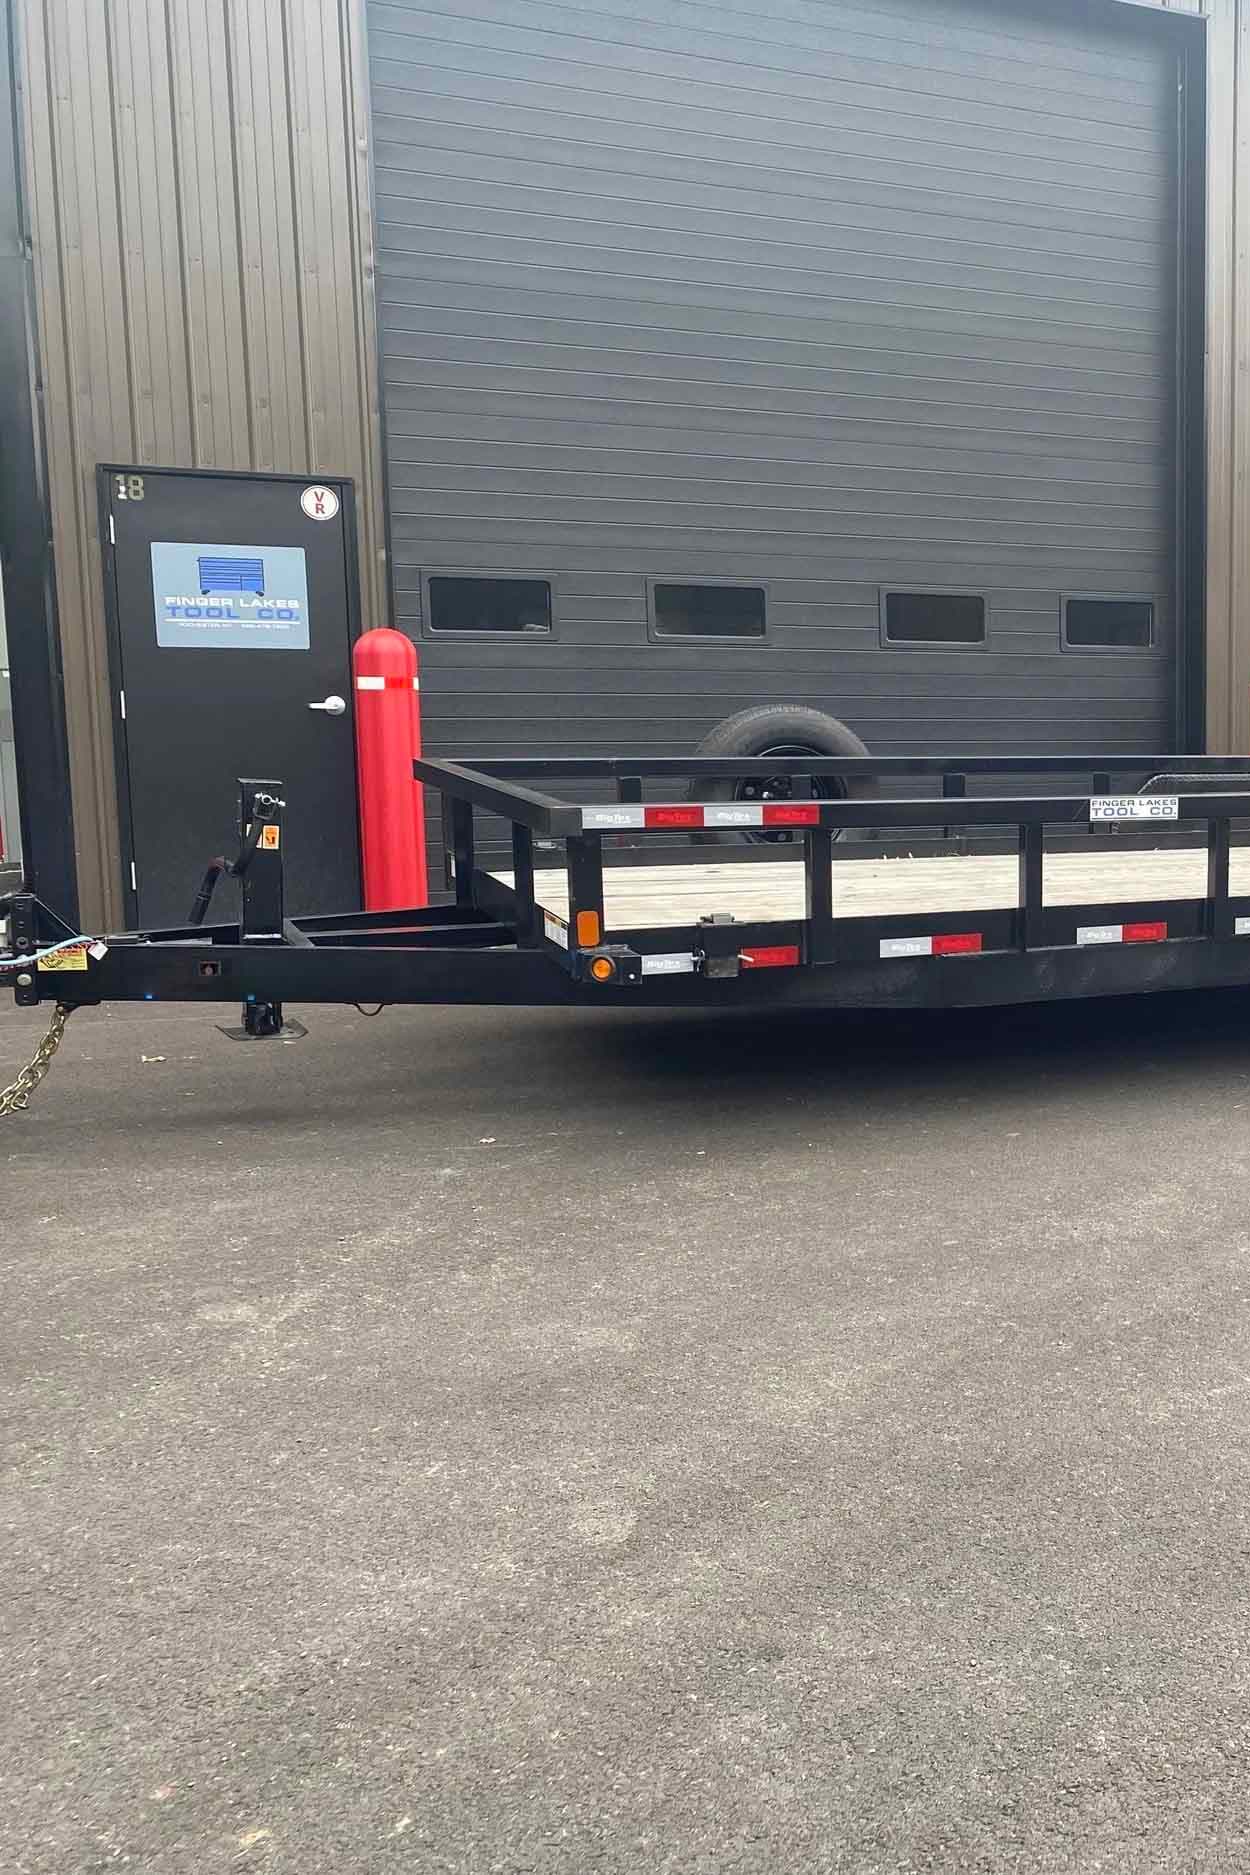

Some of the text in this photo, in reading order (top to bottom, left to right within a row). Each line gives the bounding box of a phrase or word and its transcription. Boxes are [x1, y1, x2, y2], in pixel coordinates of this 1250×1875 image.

[115, 474, 145, 500] 18
[314, 491, 324, 502] V
[315, 503, 325, 514] R
[164, 596, 300, 609] FINGER LAKES
[166, 606, 240, 619] TOOL
[1091, 799, 1135, 807] FINGER
[1091, 806, 1177, 816] TOOL CO.
